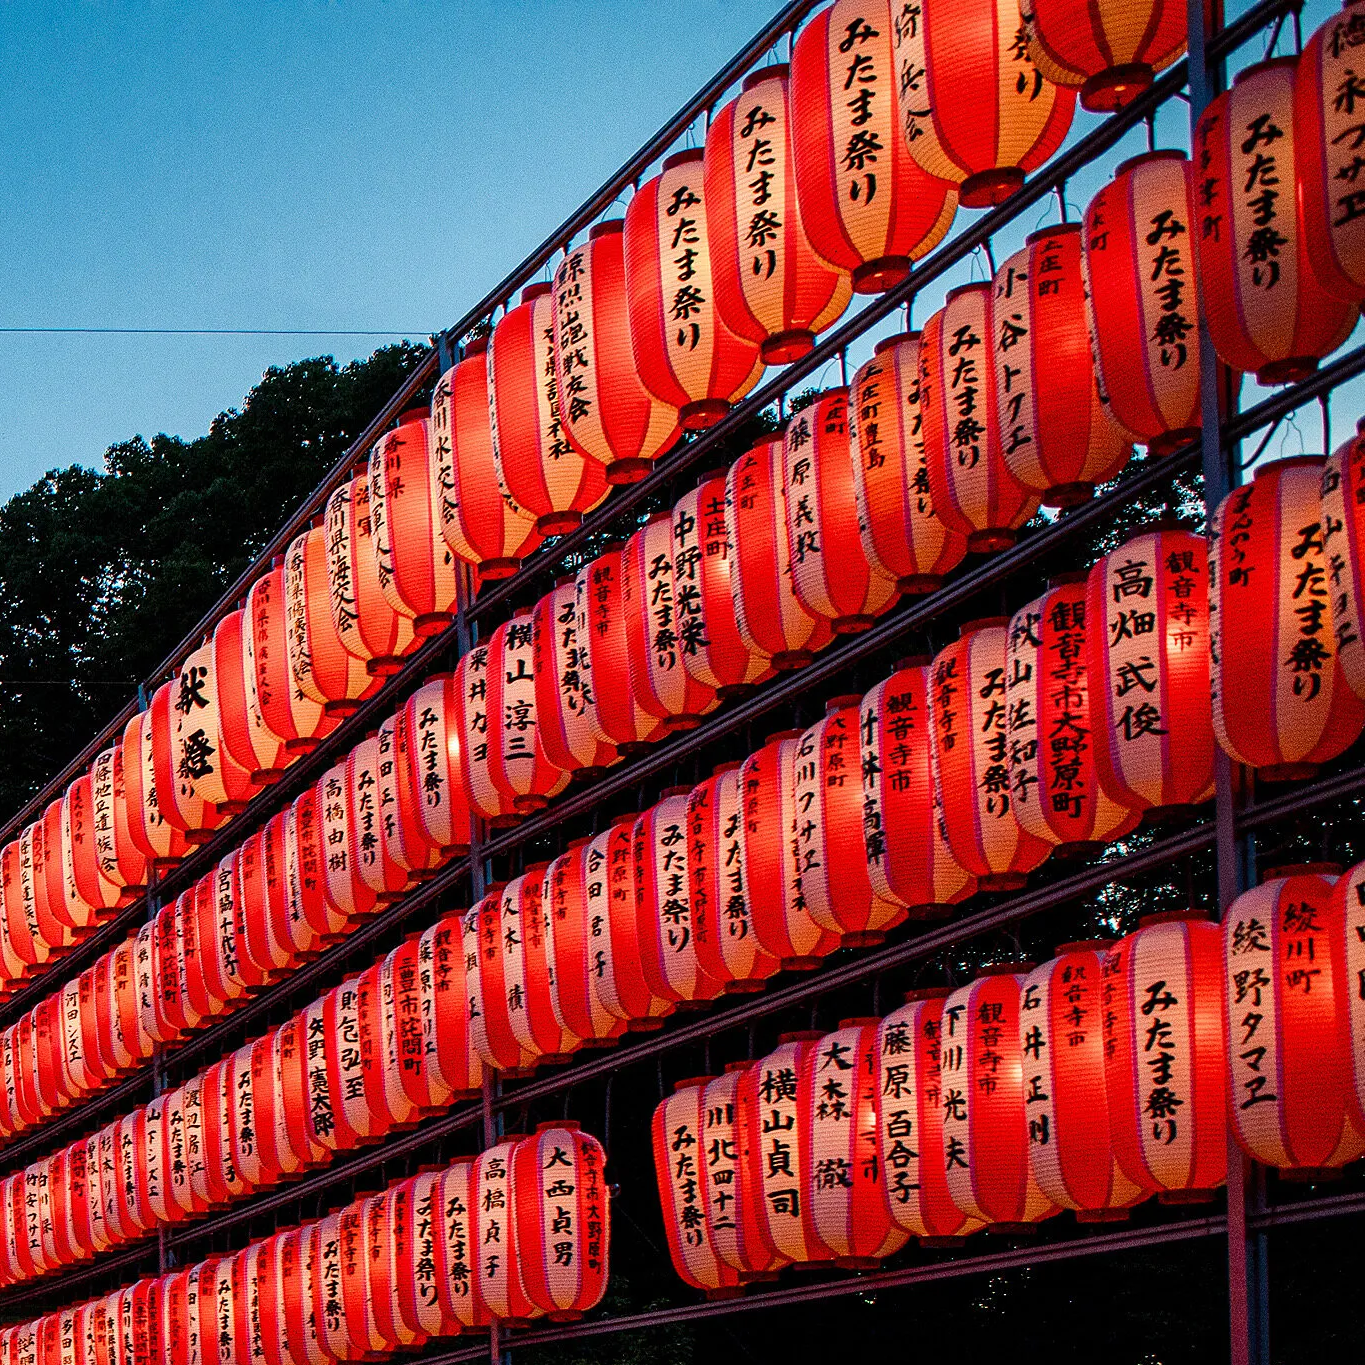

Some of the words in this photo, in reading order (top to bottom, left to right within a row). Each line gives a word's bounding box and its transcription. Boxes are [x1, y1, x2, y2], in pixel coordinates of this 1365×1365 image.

[839, 17, 884, 207] みたま祭り
[740, 105, 782, 281] みたま祭り
[1241, 114, 1287, 290] みたま祭り
[667, 186, 705, 351] みたま祭り
[1147, 210, 1194, 372] みたま祭り
[949, 325, 985, 469] みたま祭り
[385, 435, 406, 498] 香川県
[592, 567, 614, 637] 観音寺市
[647, 554, 679, 671] みたま祭り
[1109, 560, 1168, 741] 高畑武俊
[1165, 552, 1199, 652] 観音寺市
[1285, 522, 1332, 701] みたま祭り
[504, 624, 536, 761] 横山淳三
[825, 717, 848, 788] 大野原町
[886, 692, 918, 792] 観音寺市
[978, 668, 1011, 818] みたま祭り
[1048, 601, 1091, 818] 観音寺市大野原町
[358, 770, 378, 866] みたま祭り
[418, 707, 444, 808] みたま祭り
[325, 779, 347, 871] 高橋由樹
[724, 813, 748, 941] みたま祭り
[661, 825, 690, 953] みたま祭り
[1282, 902, 1322, 994] 綾川町
[977, 1002, 1006, 1095] 観音寺市
[1061, 965, 1088, 1047] 観音寺市
[1141, 981, 1184, 1145] みたま祭り
[171, 1111, 186, 1186] みたま祭り
[238, 1071, 254, 1156] みたま祭り
[758, 1069, 799, 1218] 横山貞司
[815, 1043, 854, 1189] 大森徹
[882, 1021, 921, 1204] 藤原百合子
[943, 1005, 969, 1171] 下川光夫
[483, 1158, 506, 1278] 高橋貞子
[543, 1147, 574, 1266] 大西貞男
[671, 1125, 705, 1247] みたま祭り
[708, 1104, 738, 1229] 川北四十二
[325, 1240, 341, 1331] みたま祭り
[416, 1198, 438, 1306] みたま祭り
[446, 1198, 471, 1296] みたま祭り
[219, 1280, 232, 1360] みたま祭り
